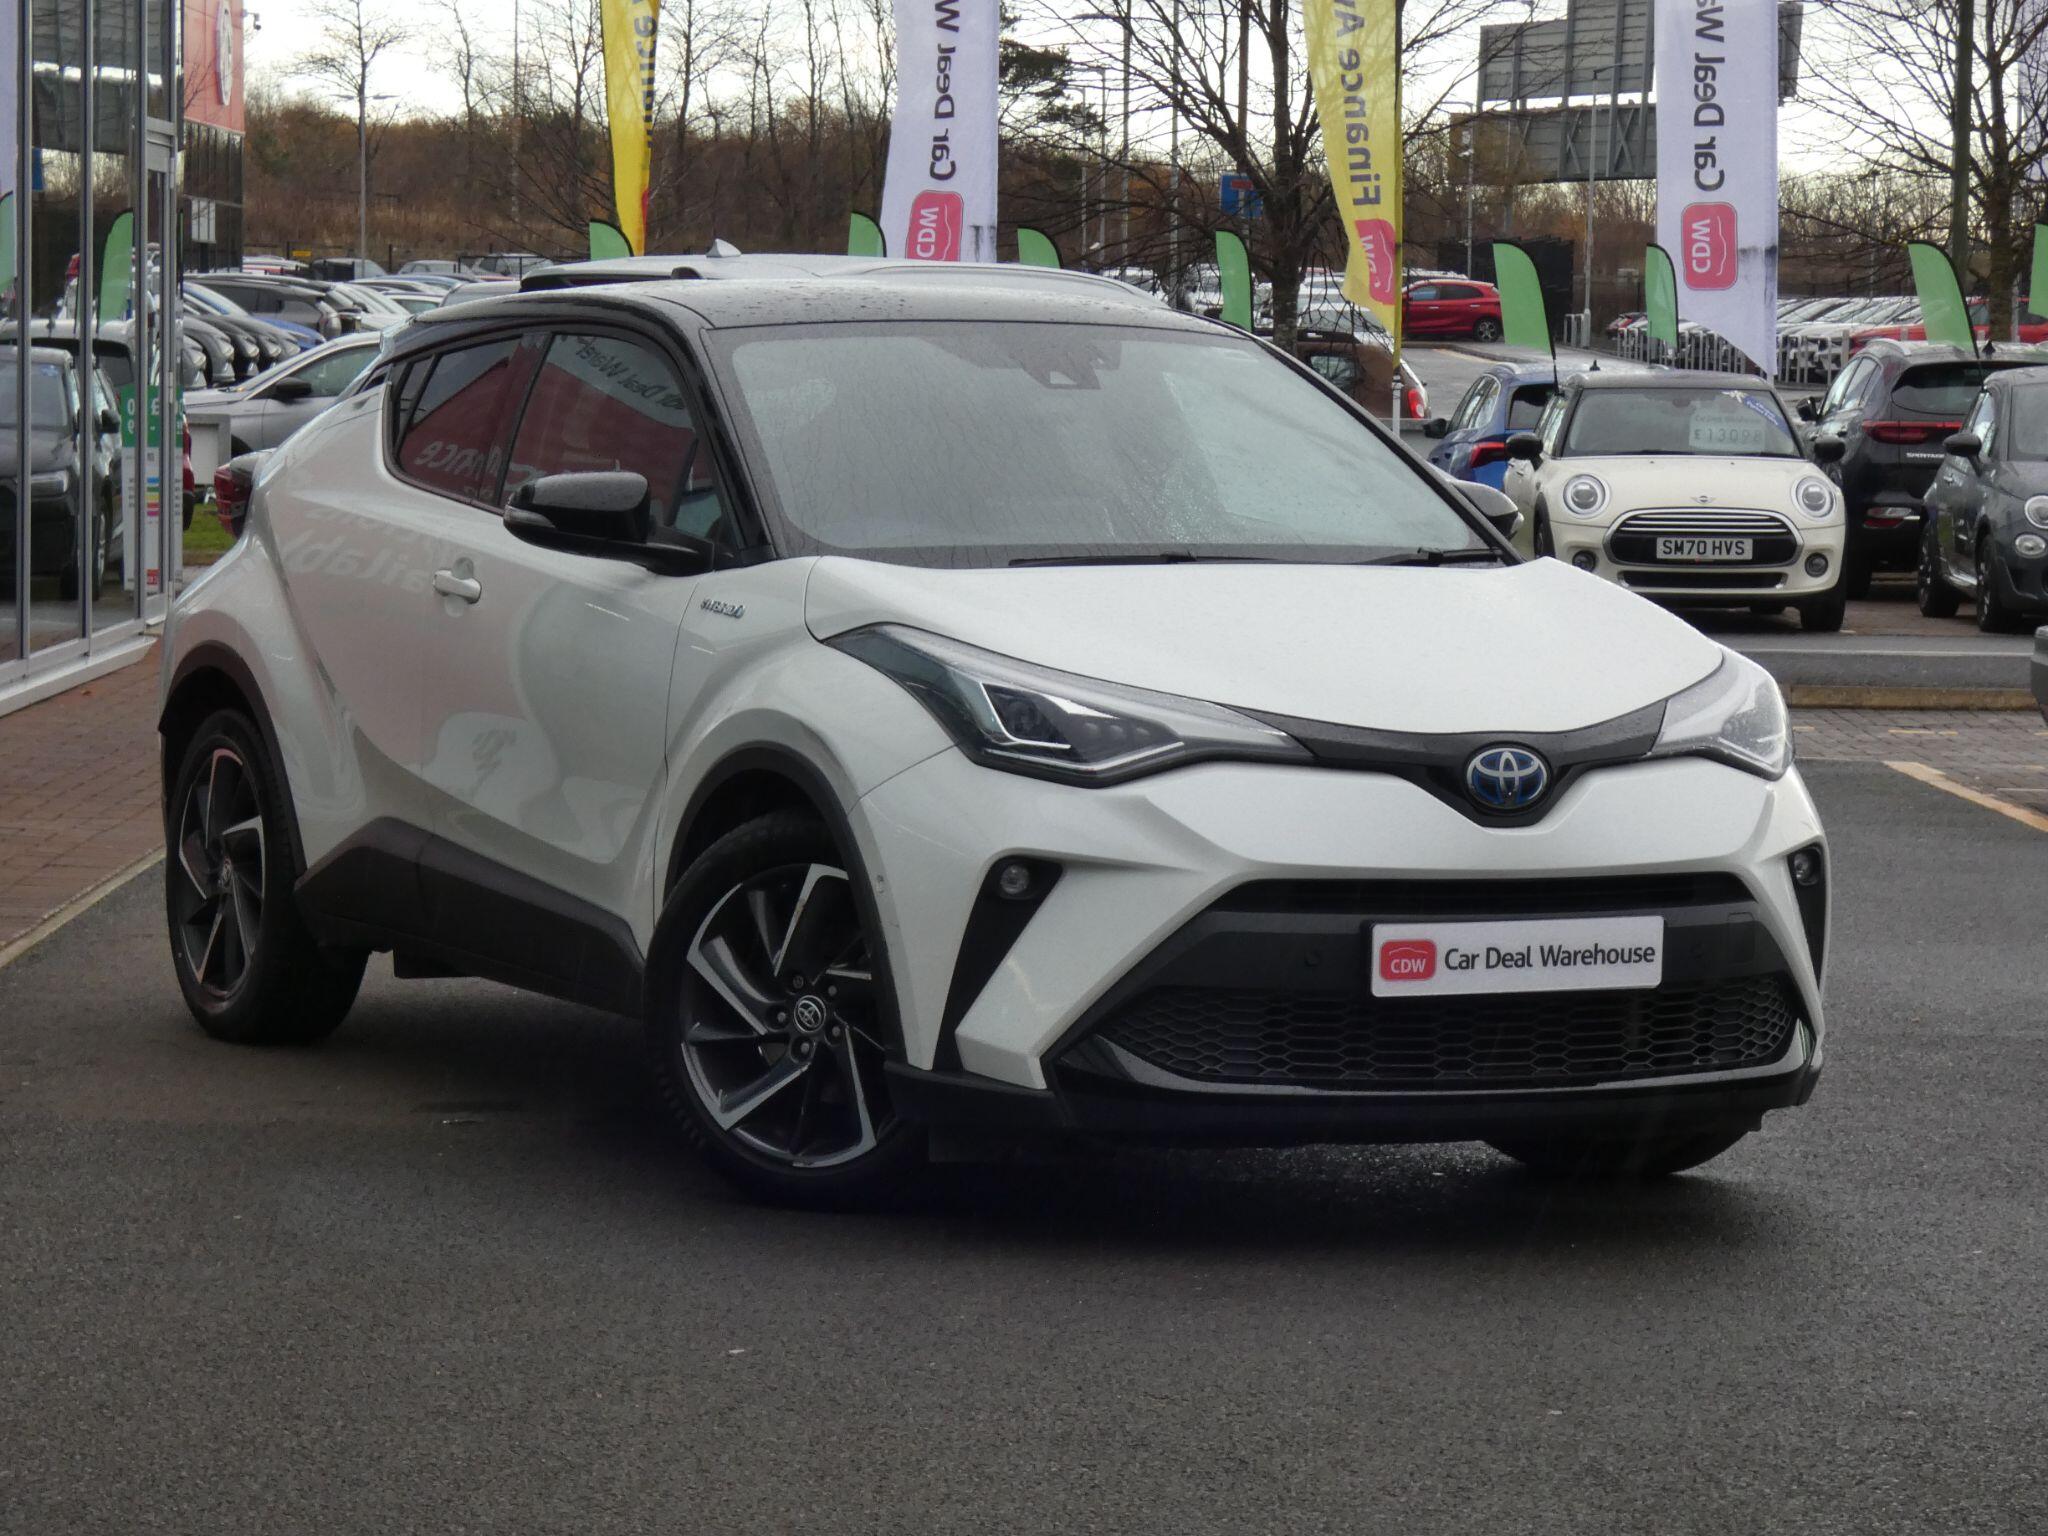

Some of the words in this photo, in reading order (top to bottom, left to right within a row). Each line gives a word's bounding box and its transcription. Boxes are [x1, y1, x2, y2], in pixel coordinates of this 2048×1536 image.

[1662, 540, 1709, 556] SM70
[1711, 540, 1746, 556] HVS
[1390, 957, 1426, 975] CDW
[1444, 948, 1480, 971] Car
[1485, 946, 1533, 969] Deal
[1539, 943, 1655, 967] Warehouse
